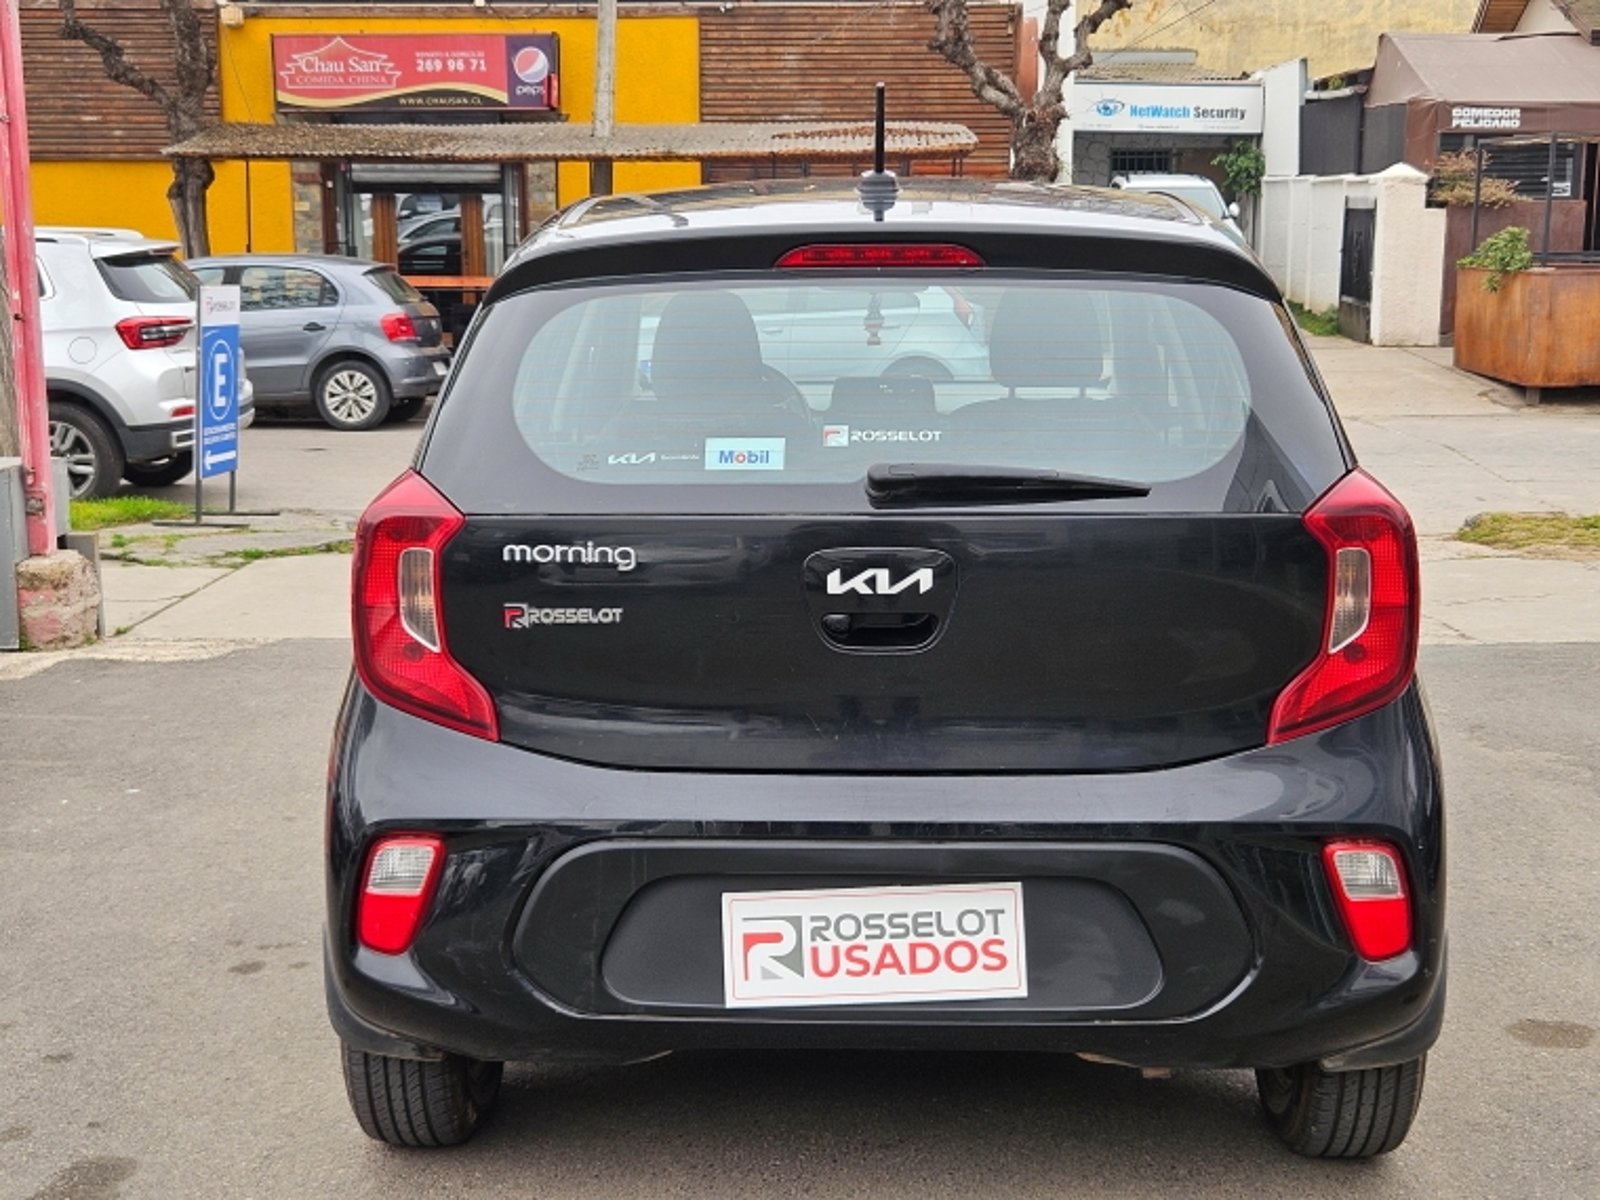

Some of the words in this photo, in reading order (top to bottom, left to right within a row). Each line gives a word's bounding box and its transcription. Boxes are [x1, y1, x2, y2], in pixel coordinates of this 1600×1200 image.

[301, 57, 345, 73] Chau
[348, 56, 380, 73] San
[416, 59, 442, 72] 269
[447, 59, 465, 72] 96
[469, 59, 487, 72] 71
[296, 75, 344, 85] COMIDA
[348, 75, 388, 85] CHINA
[515, 85, 546, 96] peps
[1130, 104, 1191, 119] NetWatch
[1193, 105, 1247, 121] Security
[850, 429, 942, 442] ROSSELOT
[719, 449, 770, 464] Mobil
[503, 541, 637, 572] morning
[827, 567, 934, 595] KIA
[529, 607, 624, 625] ROSSELOT
[809, 908, 1006, 943] ROSSELOT
[810, 938, 1009, 980] USADOS
